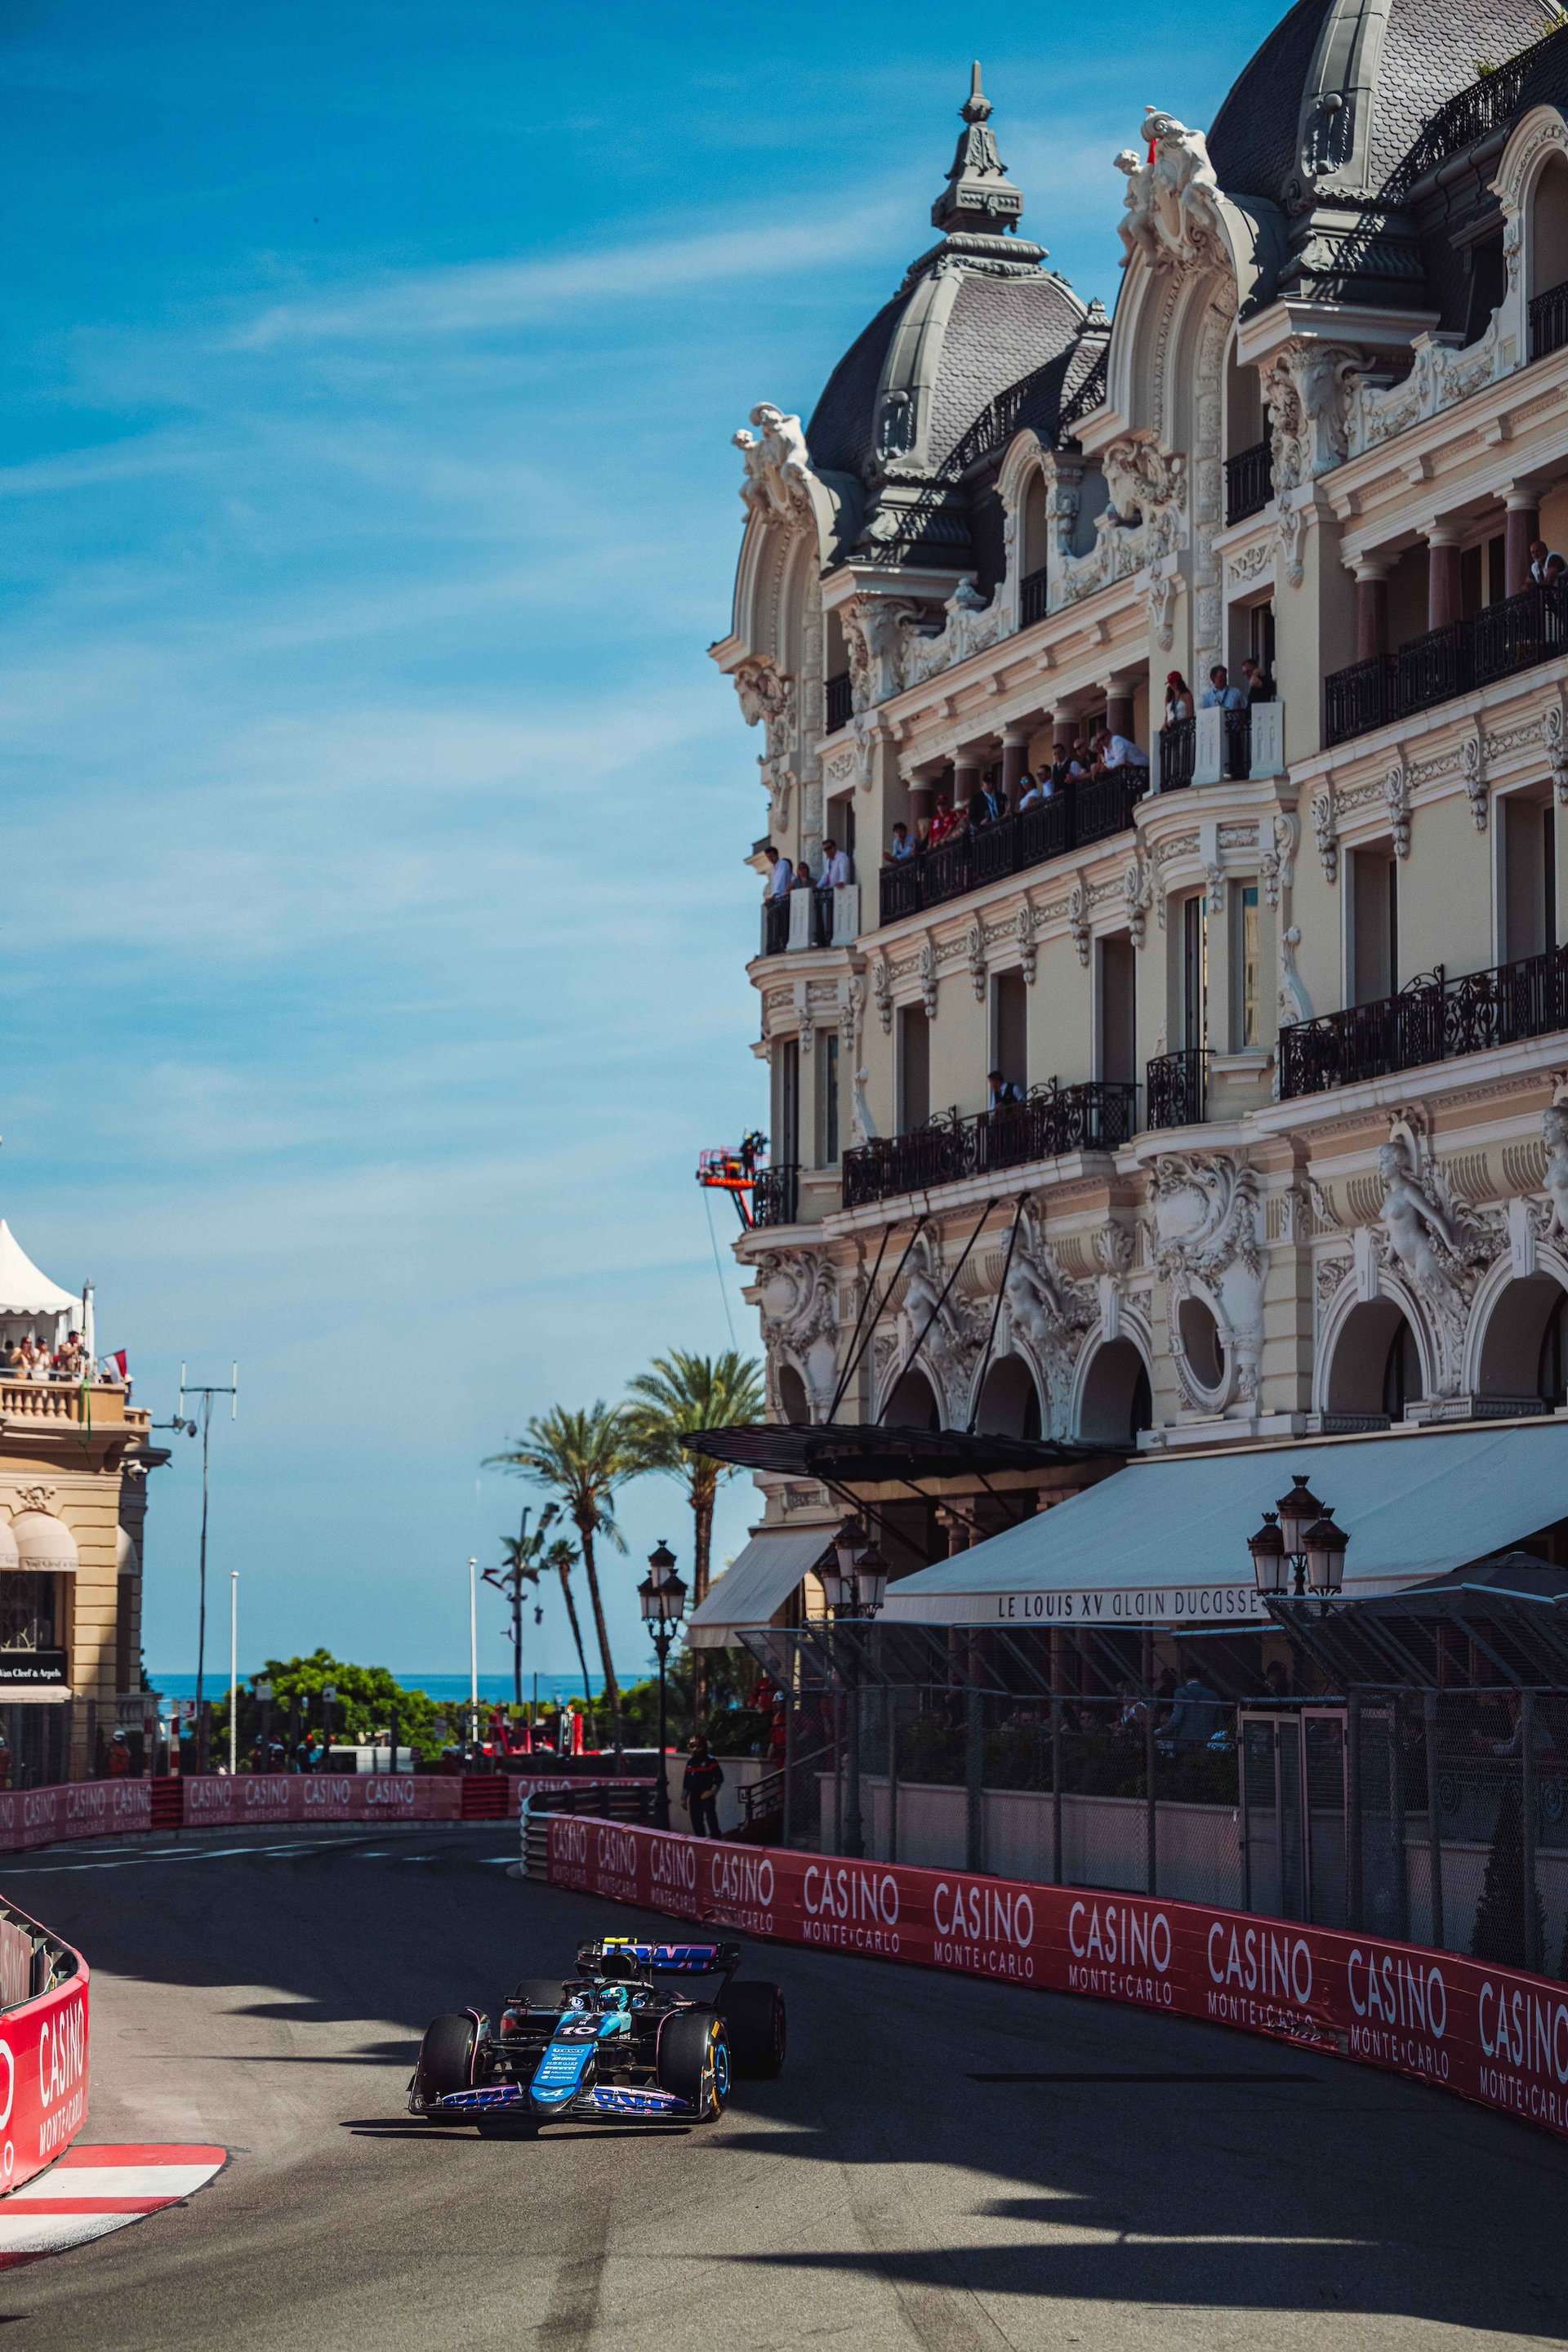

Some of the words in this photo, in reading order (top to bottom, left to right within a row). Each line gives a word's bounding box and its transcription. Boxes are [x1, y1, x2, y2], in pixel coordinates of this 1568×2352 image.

[998, 1597, 1015, 1618] LE
[1024, 1595, 1072, 1618] LOUIS
[1082, 1594, 1102, 1616] XV
[12, 1668, 32, 1677] Cleef
[39, 1668, 62, 1679] Arpels
[24, 1792, 56, 1827] CASINO
[66, 1787, 106, 1819] CASINO
[190, 1780, 232, 1809] CASINO
[245, 1779, 290, 1806] CASINO
[304, 1779, 350, 1804] CASINO
[366, 1779, 415, 1804] CASINO
[553, 1821, 588, 1864] CASINO
[598, 1829, 637, 1877] CASINO
[650, 1838, 696, 1891] CASINO
[712, 1852, 774, 1907] CASINO
[804, 1865, 899, 1926] CASINO
[933, 1882, 1034, 1949] CASINO
[741, 1909, 773, 1932] CARLO
[803, 1920, 847, 1945] MONTE
[856, 1927, 900, 1953] CARLO
[1069, 1901, 1171, 1973] CASINO
[933, 1940, 980, 1969] MONTE
[989, 1949, 1034, 1979] CARLO
[1207, 1922, 1312, 2004] CASINO
[1069, 1964, 1116, 1994] MONTE
[1125, 1974, 1172, 2006] CARLO
[1348, 1949, 1446, 2039] CASINO
[1208, 1990, 1256, 2025] MONTE
[560, 2027, 598, 2035] 10
[1351, 2024, 1398, 2063] MONTE
[1407, 2039, 1449, 2079] CARLO
[1479, 1981, 1568, 2085] CASINO
[39, 1998, 85, 2108] CASINO
[1480, 2065, 1522, 2109] MONTE
